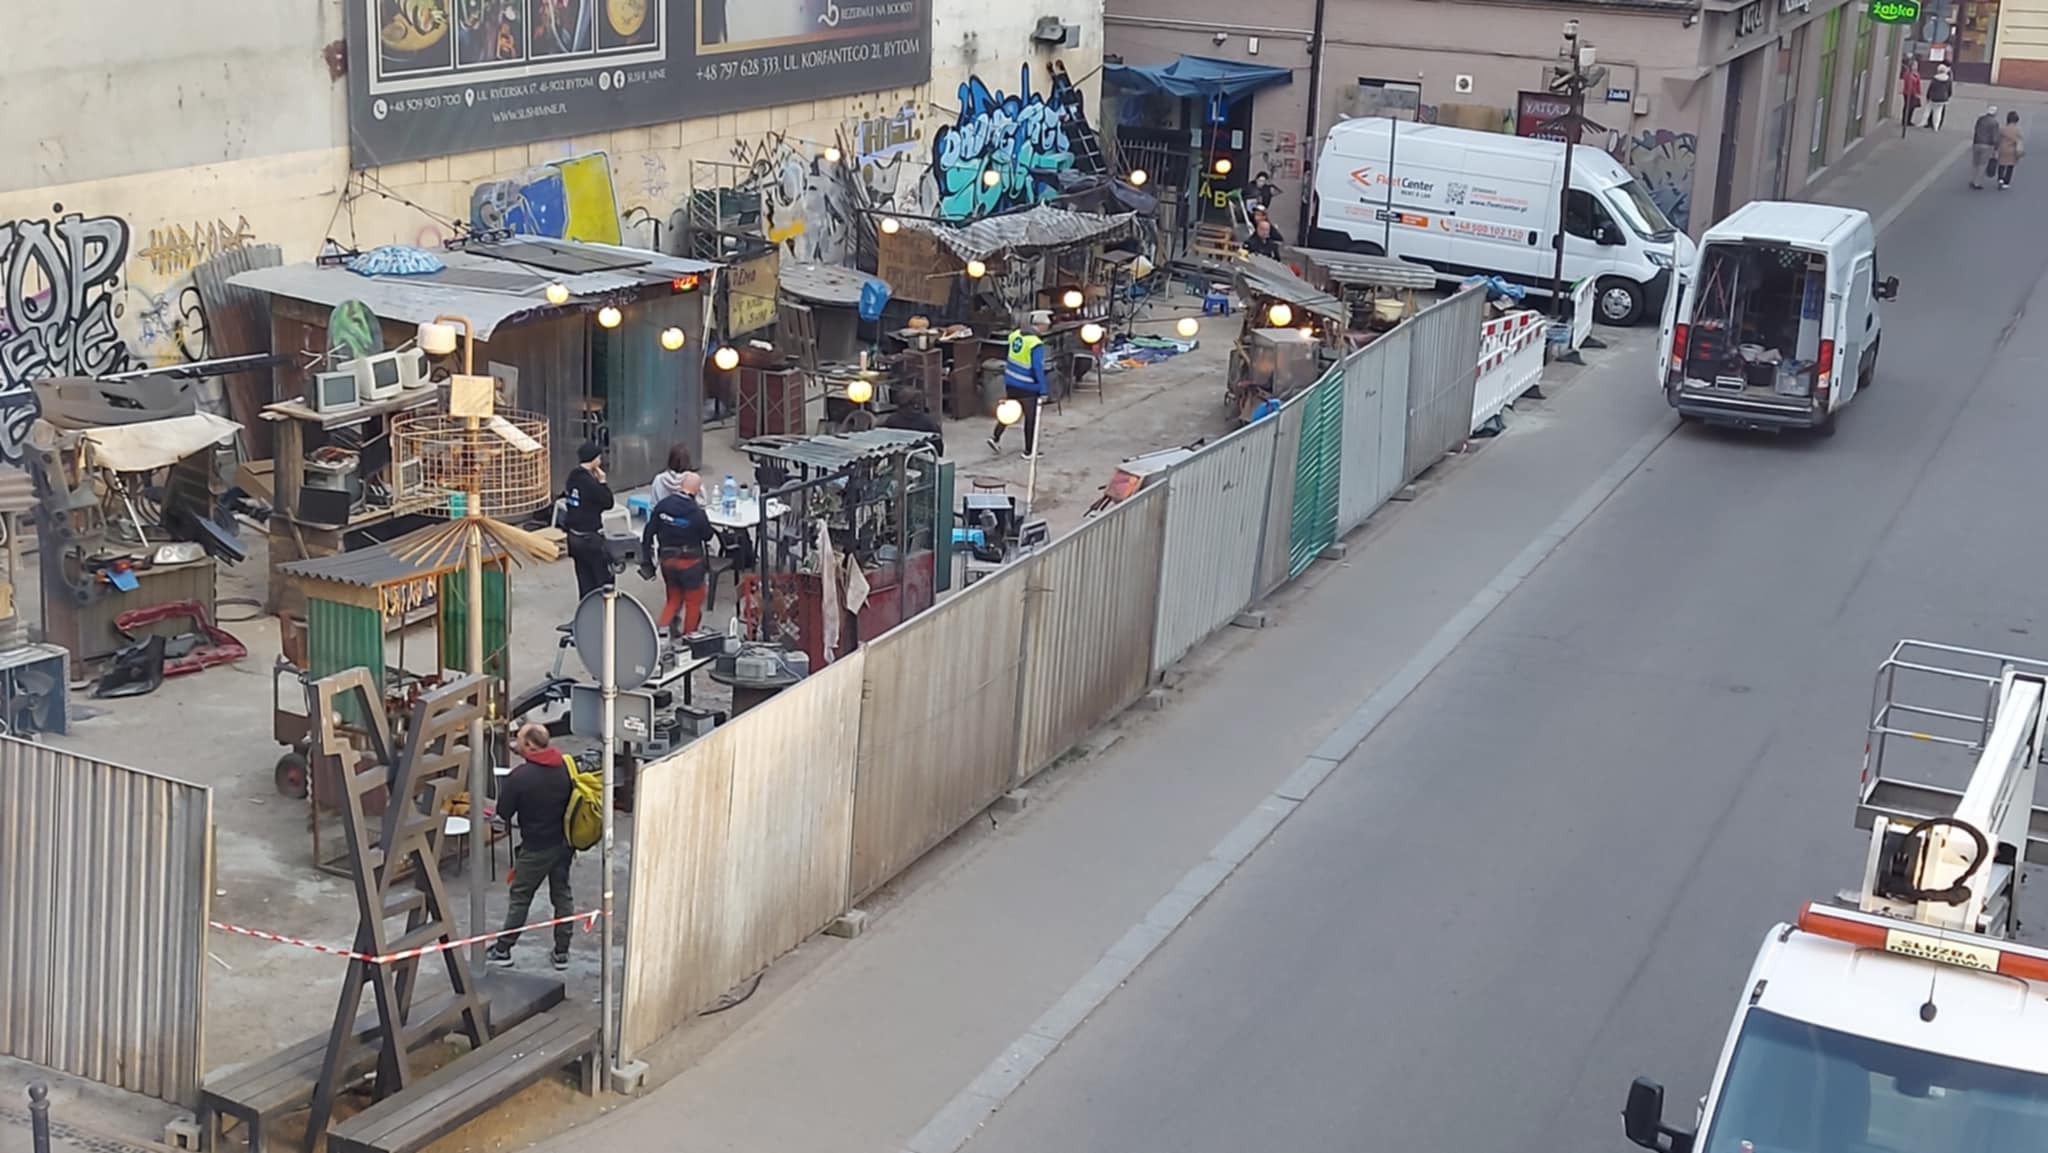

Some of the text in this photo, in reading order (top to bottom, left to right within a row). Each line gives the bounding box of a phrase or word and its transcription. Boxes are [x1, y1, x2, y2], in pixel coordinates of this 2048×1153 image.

[1873, 1, 1915, 18] żabka
[696, 66, 717, 81] +48
[719, 61, 738, 80] 797
[740, 59, 759, 76] 628
[801, 43, 870, 69] KORFANTEGO
[884, 39, 920, 57] BYTOM
[407, 98, 423, 111] 509
[442, 94, 461, 106] 700
[490, 83, 528, 99] RYCERSKA
[566, 77, 594, 90] BYTOM
